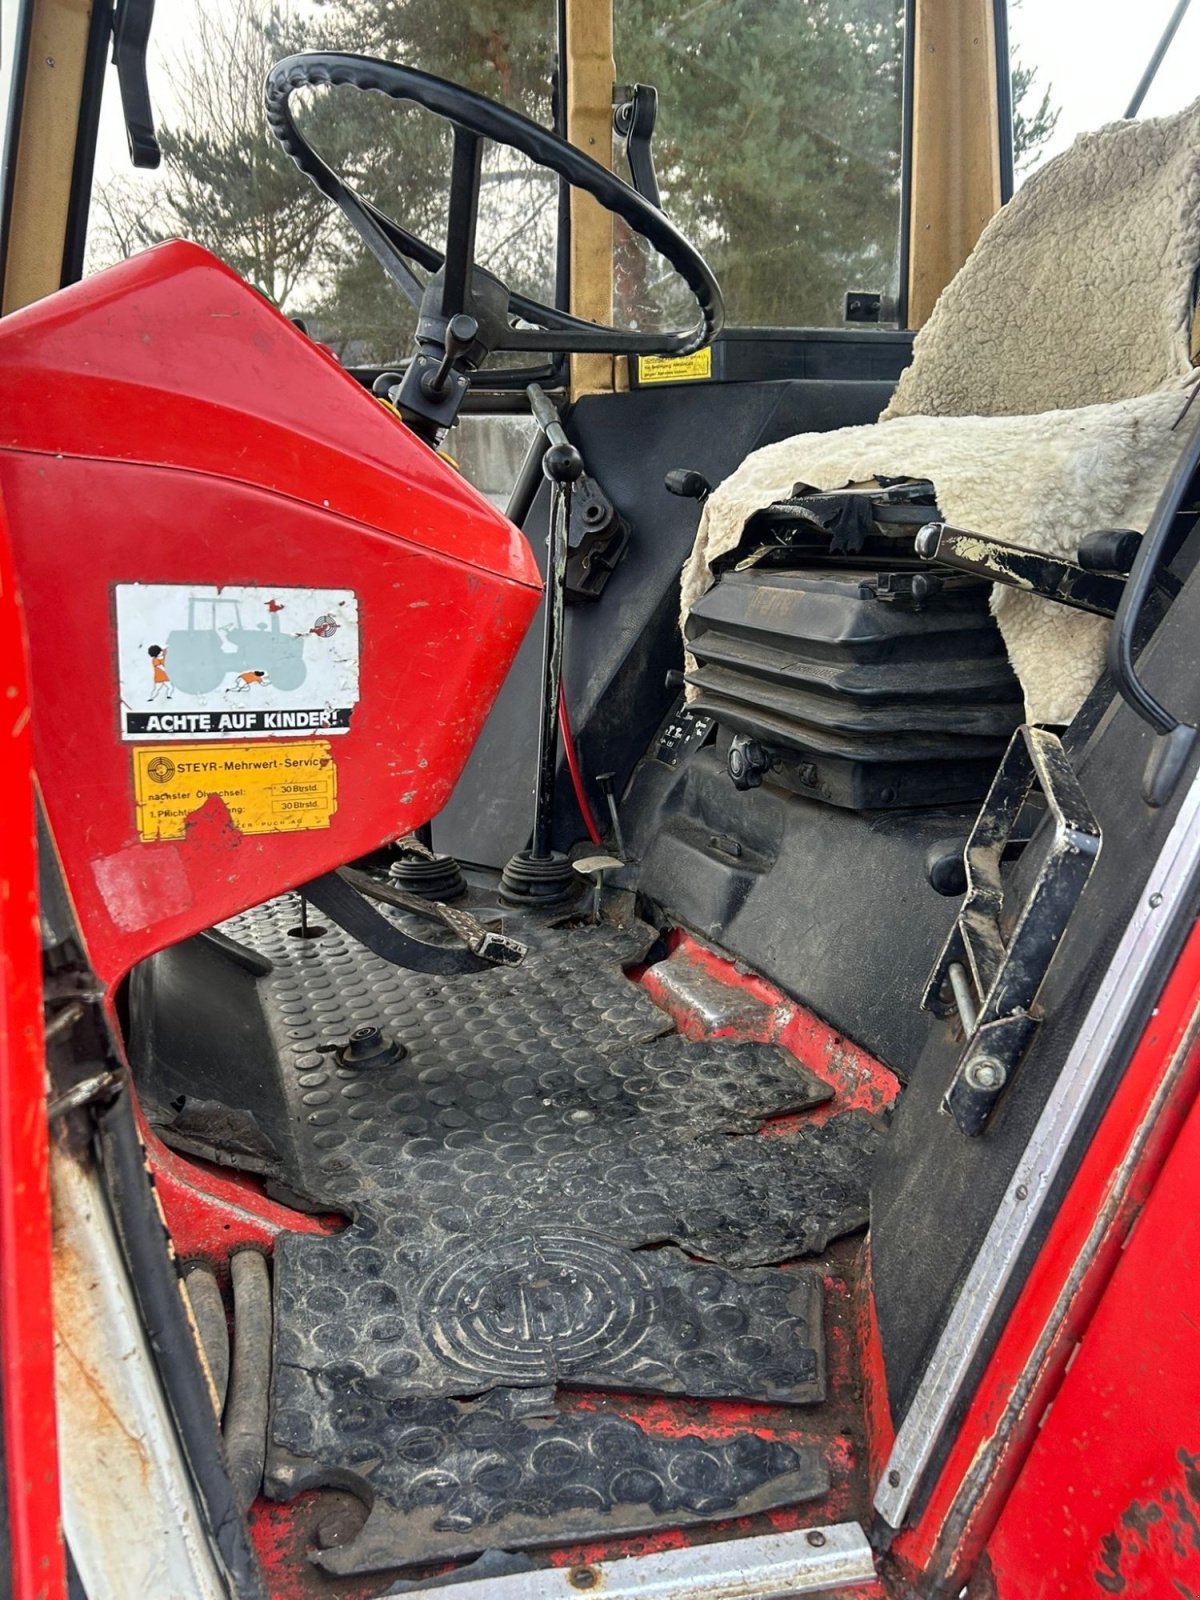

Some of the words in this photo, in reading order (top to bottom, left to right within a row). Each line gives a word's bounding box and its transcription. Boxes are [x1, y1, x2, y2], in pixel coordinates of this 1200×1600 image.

[146, 714, 211, 732] ACHTE
[218, 713, 257, 730] AUF
[264, 711, 338, 729] KINDER!
[281, 785, 292, 793] 30
[281, 802, 292, 810] 30
